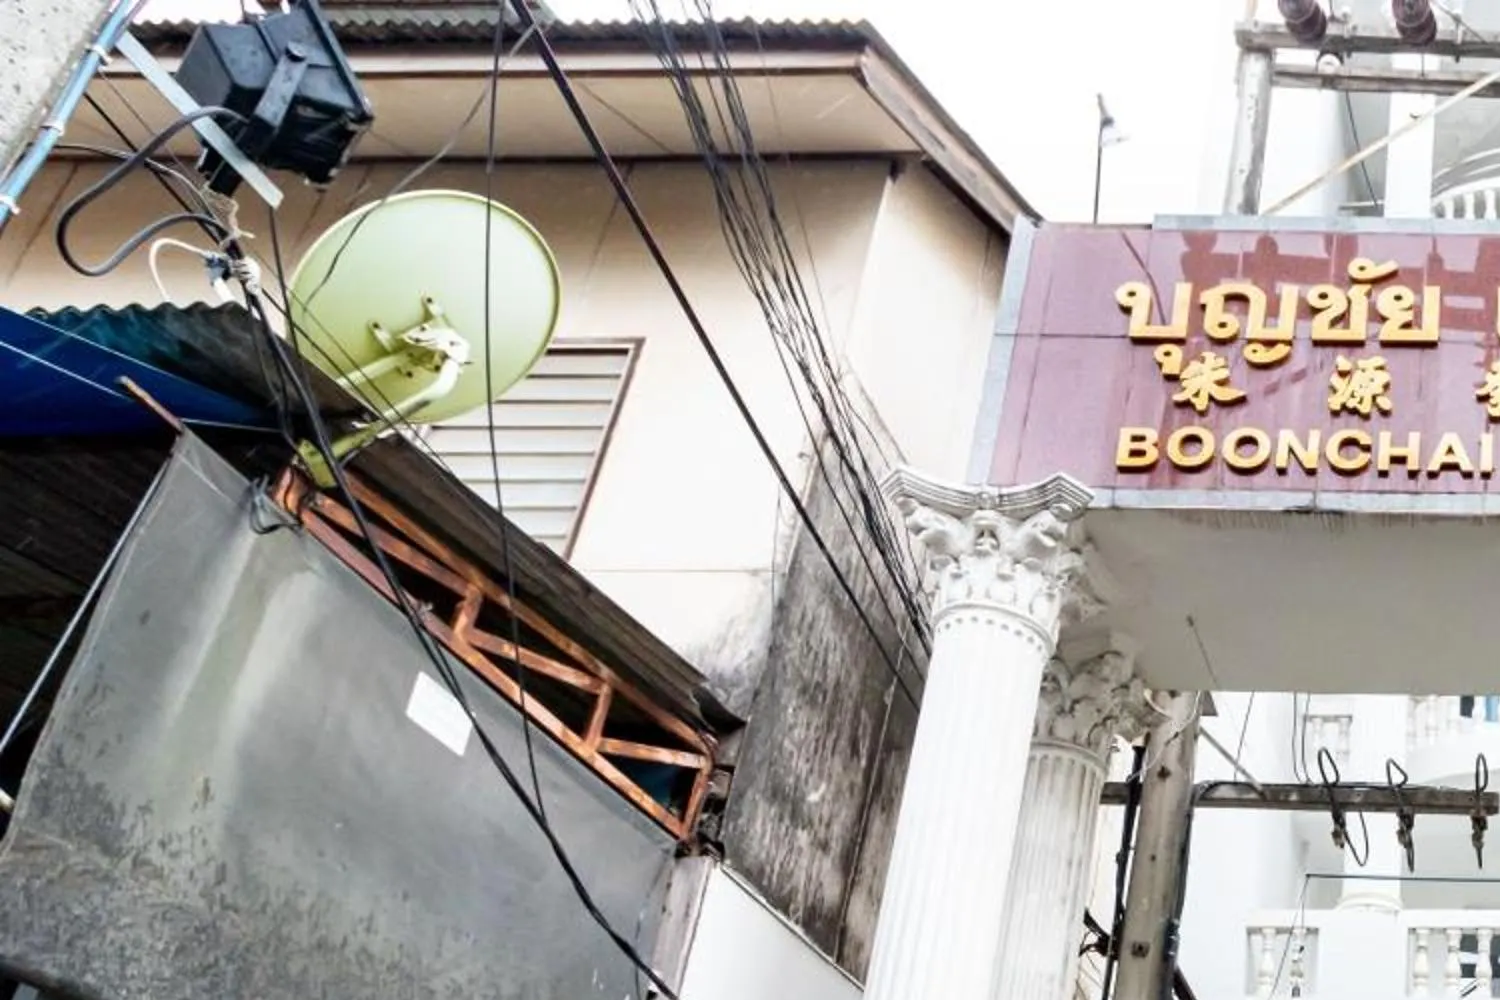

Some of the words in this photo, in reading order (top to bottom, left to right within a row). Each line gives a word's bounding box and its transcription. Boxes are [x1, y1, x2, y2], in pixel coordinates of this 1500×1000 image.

[1115, 258, 1441, 379] บุญชัย
[1116, 426, 1494, 478] BOONCHAI
